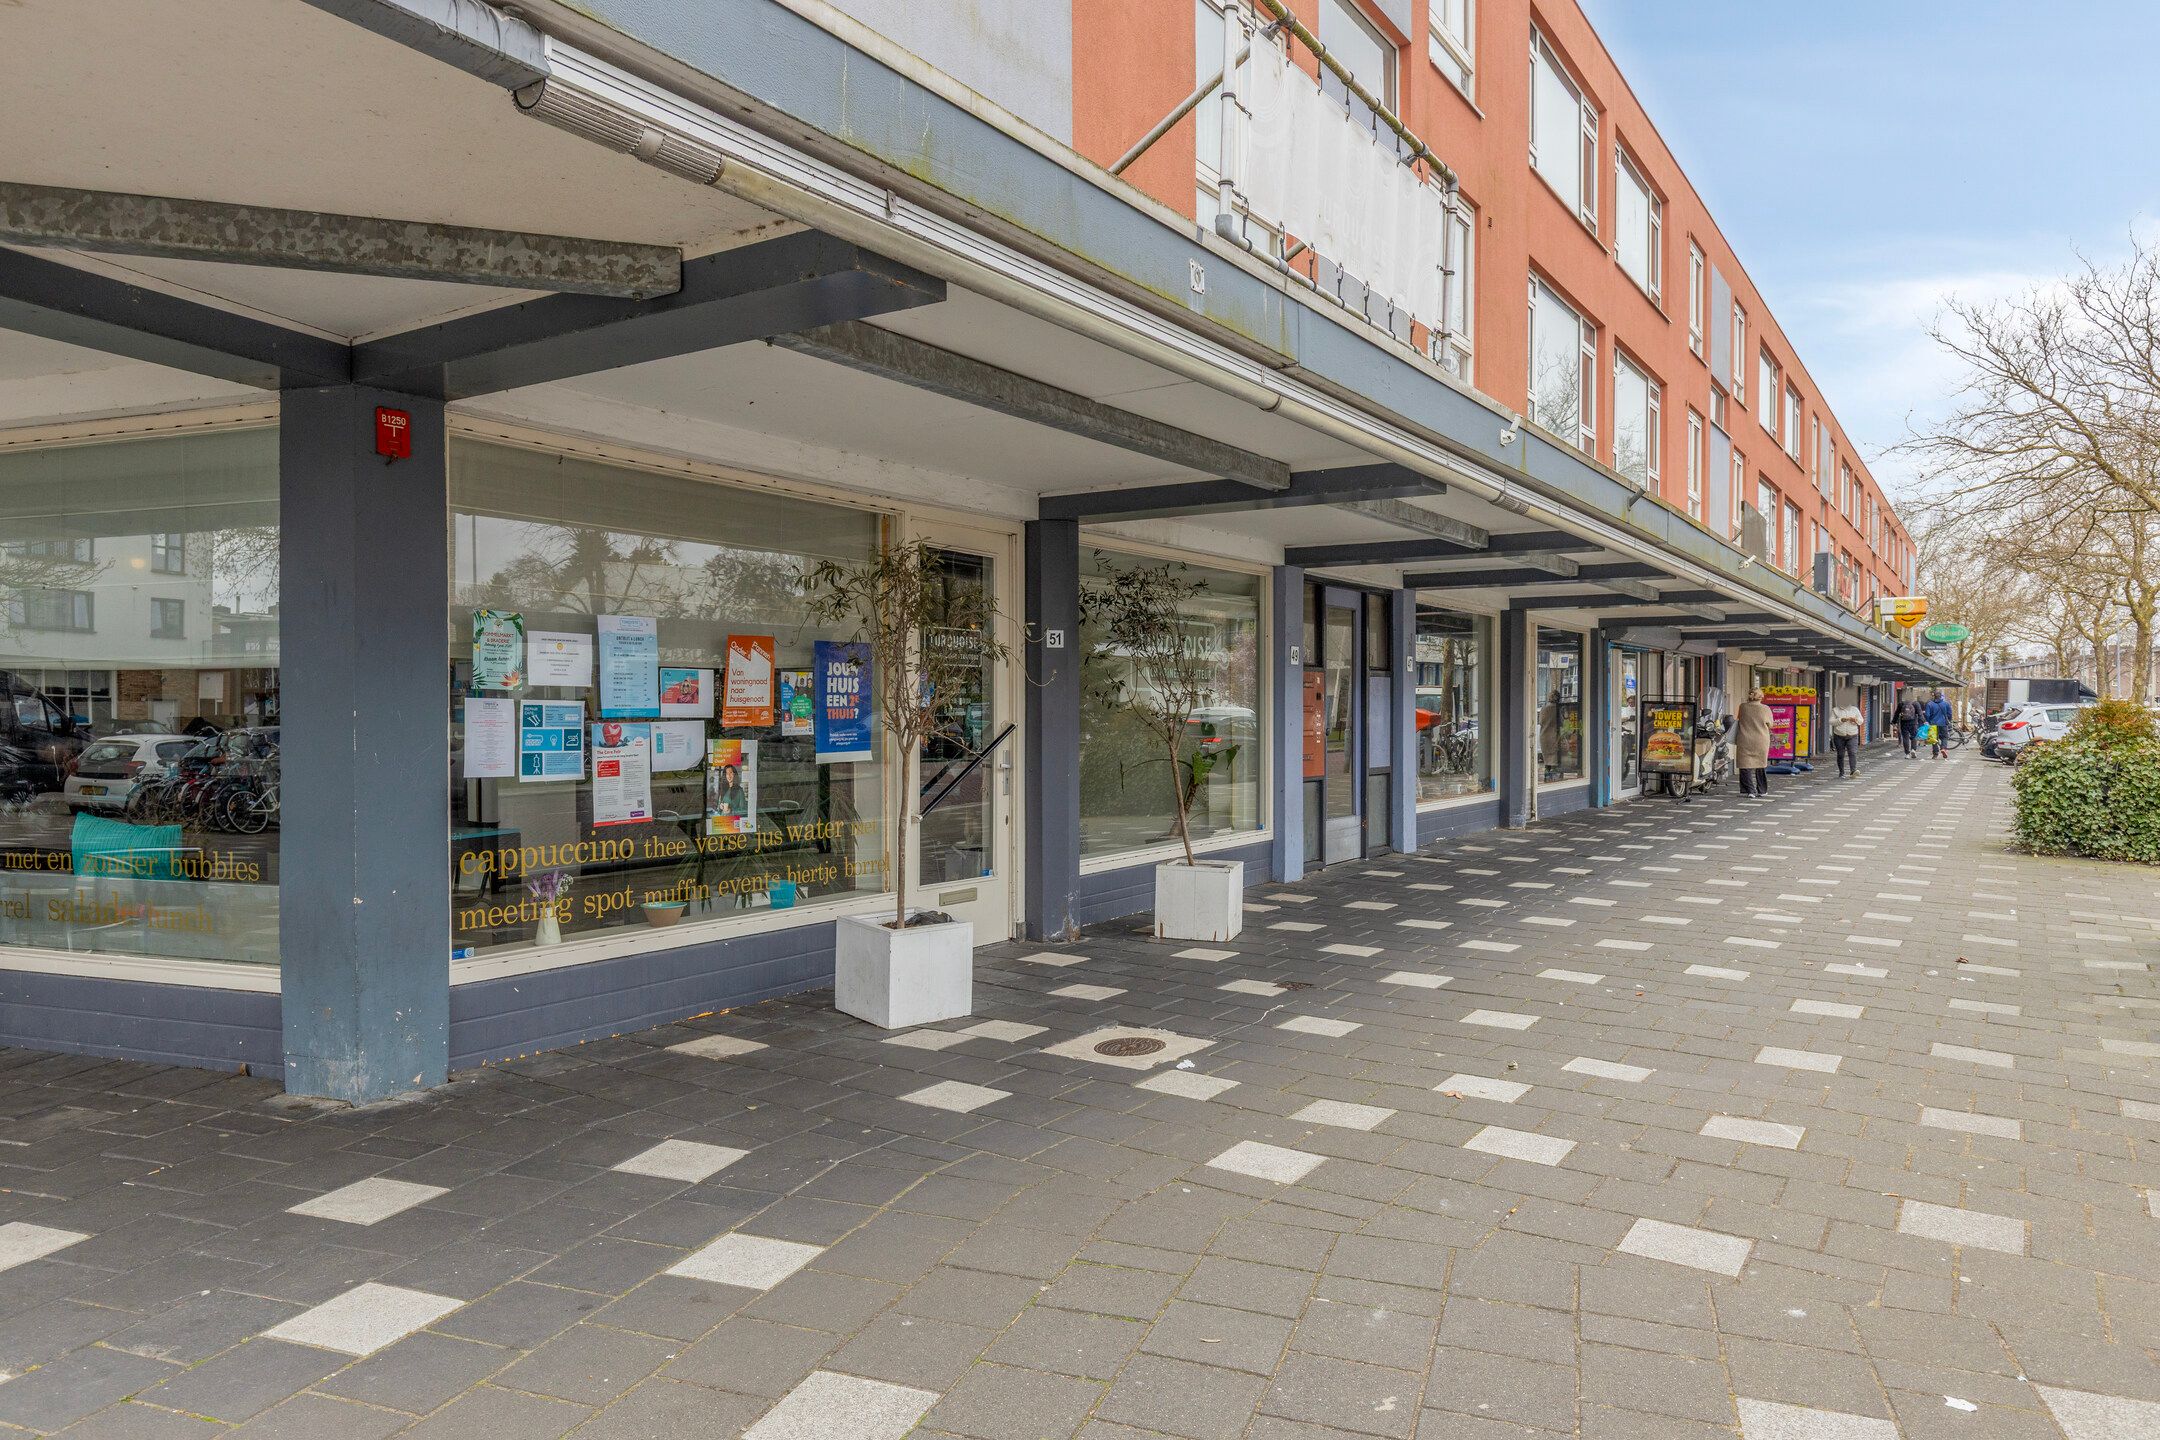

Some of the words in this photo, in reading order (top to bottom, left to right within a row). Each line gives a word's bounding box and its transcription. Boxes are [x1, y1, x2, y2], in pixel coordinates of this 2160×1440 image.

[381, 413, 407, 426] B1250
[1050, 633, 1061, 646] 51
[1291, 649, 1299, 662] 49
[732, 669, 745, 677] Van
[730, 677, 768, 687] woningnood
[827, 677, 860, 694] HUIS
[730, 694, 765, 705] huisgenoot
[826, 694, 848, 707] EEN
[827, 707, 859, 720] THUIS?
[1654, 711, 1683, 721] TOWER
[1653, 719, 1683, 728] CHICKEN
[459, 831, 635, 880] cappuccino
[643, 836, 688, 859] thee
[695, 832, 748, 854] verse
[754, 825, 784, 854] jus
[785, 816, 845, 843] water
[4, 848, 42, 870] met
[47, 851, 74, 871] en
[83, 846, 159, 876] zonder
[169, 848, 261, 882] bubbles
[458, 892, 574, 931] meeting
[583, 884, 636, 919] spot
[644, 878, 711, 904] muffin
[717, 870, 781, 898] events
[786, 860, 838, 885] biertje
[843, 856, 890, 878] borrel
[146, 897, 214, 934] lunch
